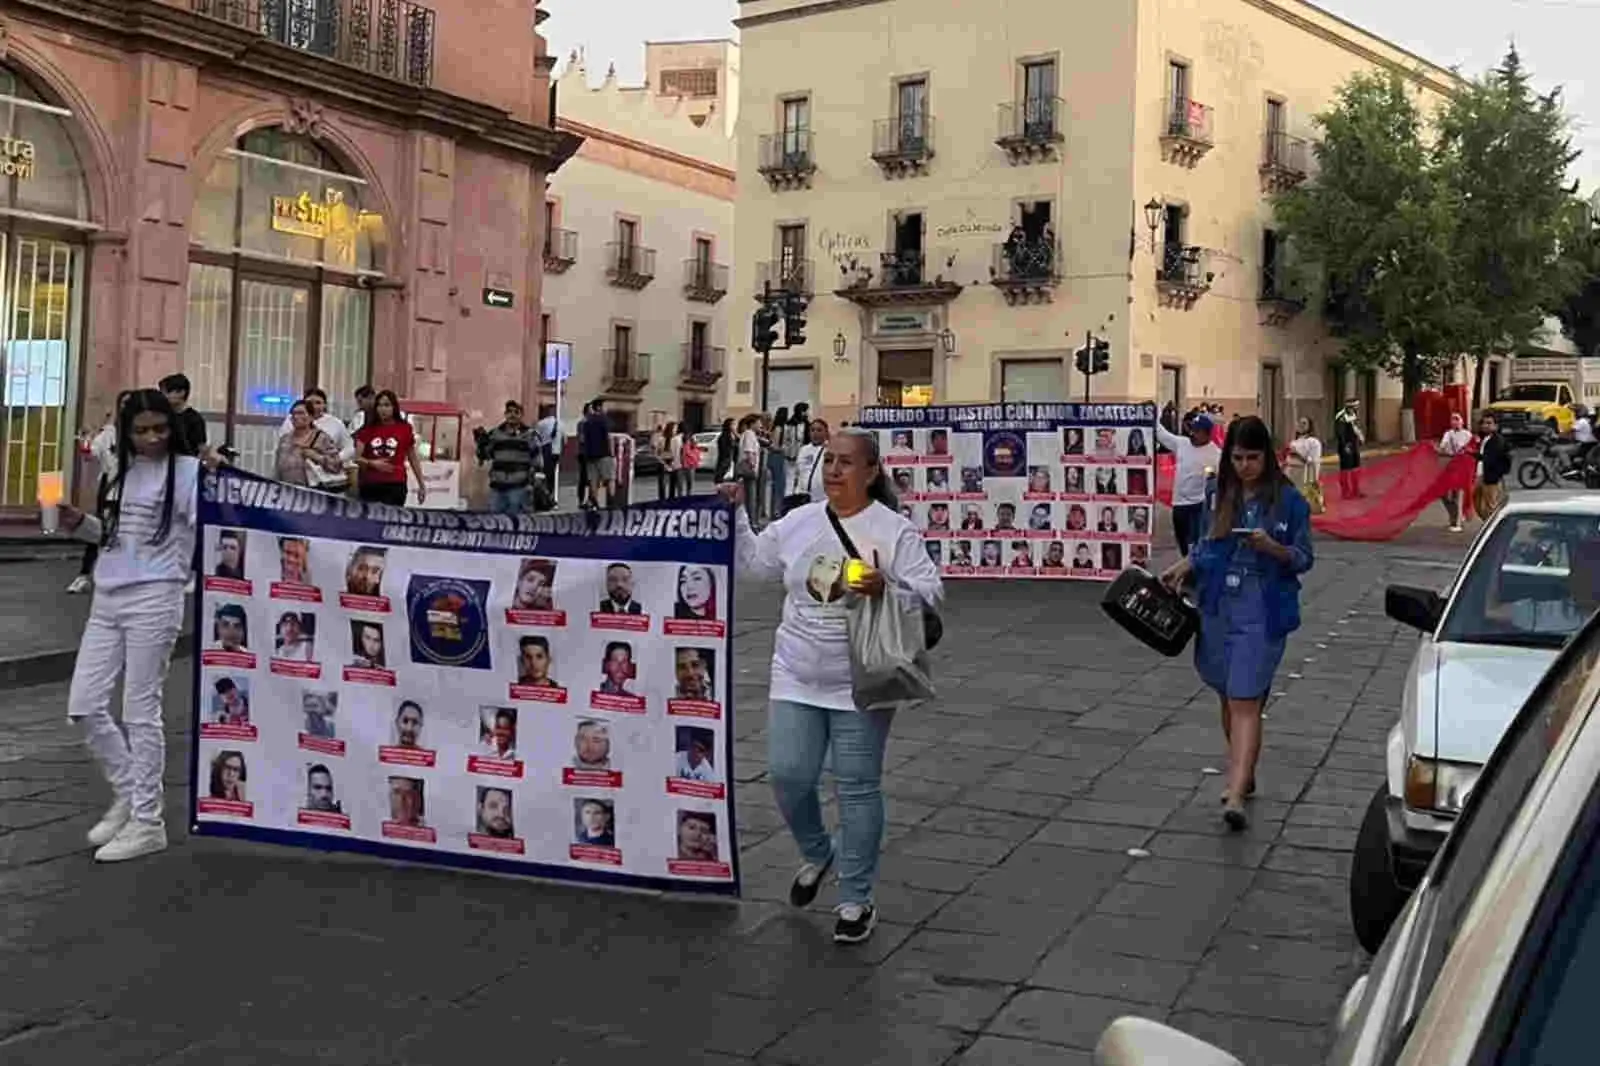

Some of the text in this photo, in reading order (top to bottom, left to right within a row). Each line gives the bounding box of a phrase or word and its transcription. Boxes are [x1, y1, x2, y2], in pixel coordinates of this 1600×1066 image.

[1079, 404, 1154, 420] ZACATECAS
[202, 472, 327, 515] SIGUIENDO
[595, 508, 730, 541] ZACATECAS
